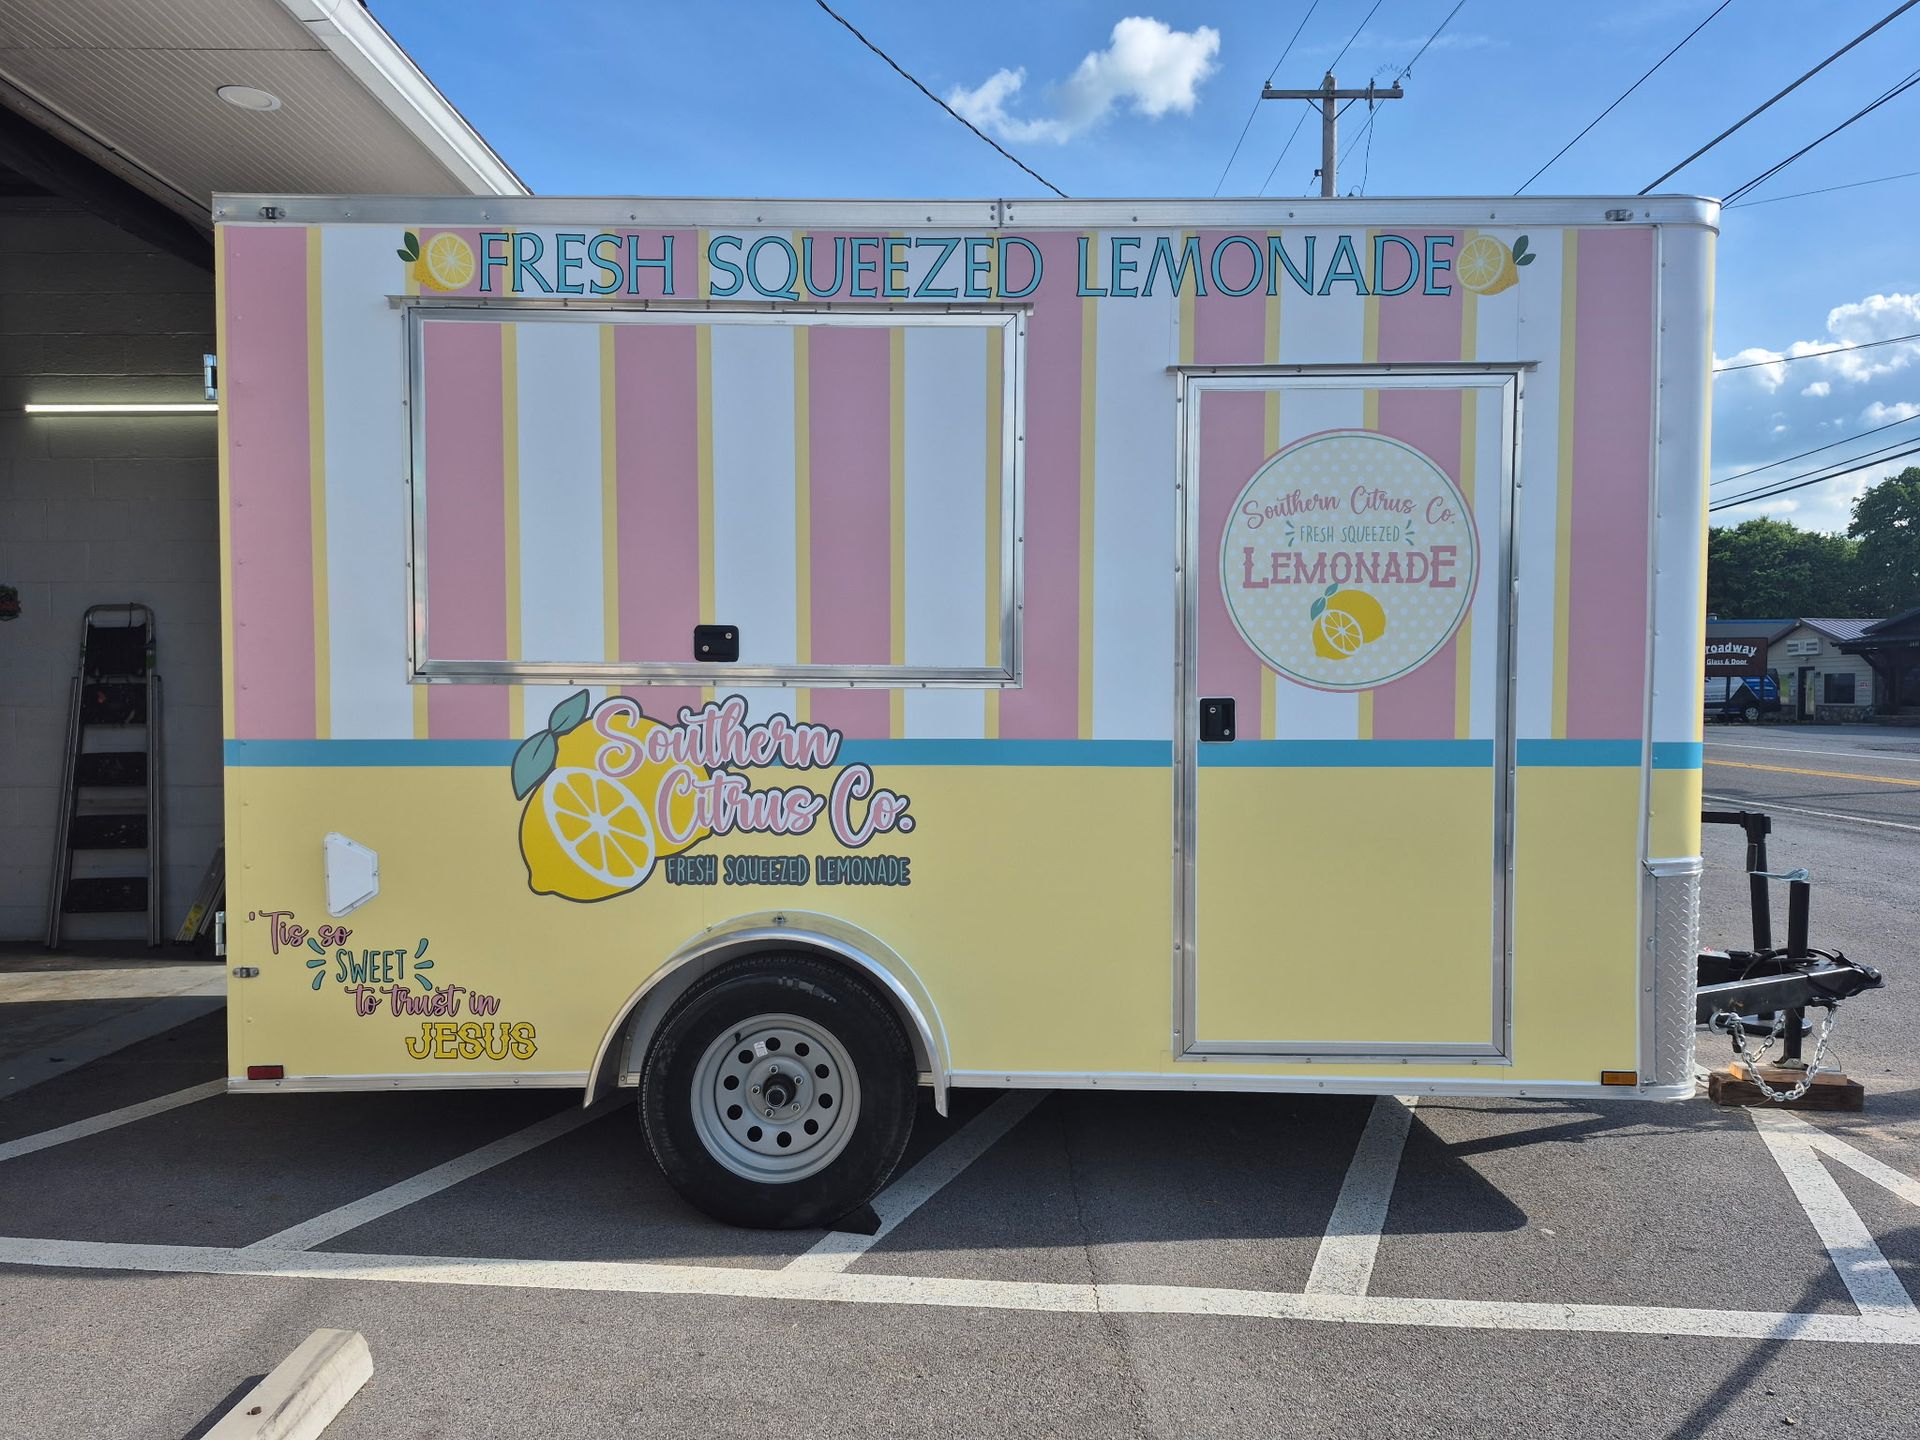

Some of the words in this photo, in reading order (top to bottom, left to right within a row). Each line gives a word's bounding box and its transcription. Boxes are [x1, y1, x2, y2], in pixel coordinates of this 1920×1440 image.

[479, 232, 674, 296] FRESH
[708, 234, 1043, 301] SQUEEZED
[1076, 235, 1454, 297] LEMONADE
[1242, 489, 1340, 529] Southern
[1350, 486, 1417, 515] Citrus
[1426, 496, 1456, 525] Co.
[1300, 526, 1334, 543] FRESH
[1341, 525, 1400, 544] SQUEEZED
[1243, 546, 1457, 589] LEMONADE
[1705, 642, 1757, 657] roadway
[592, 694, 843, 778] Southern
[655, 765, 826, 845] Citrus
[828, 763, 916, 848] Co.
[666, 855, 718, 886] FRESH
[723, 855, 810, 886] SQUEEZED
[815, 855, 911, 886] LEMONADE
[249, 910, 309, 954] 'Tis
[317, 924, 352, 947] so
[335, 948, 407, 984] SWEET
[344, 983, 382, 1017] to
[379, 983, 466, 1017] trust
[468, 991, 501, 1017] in
[405, 1022, 538, 1060] JESUS
